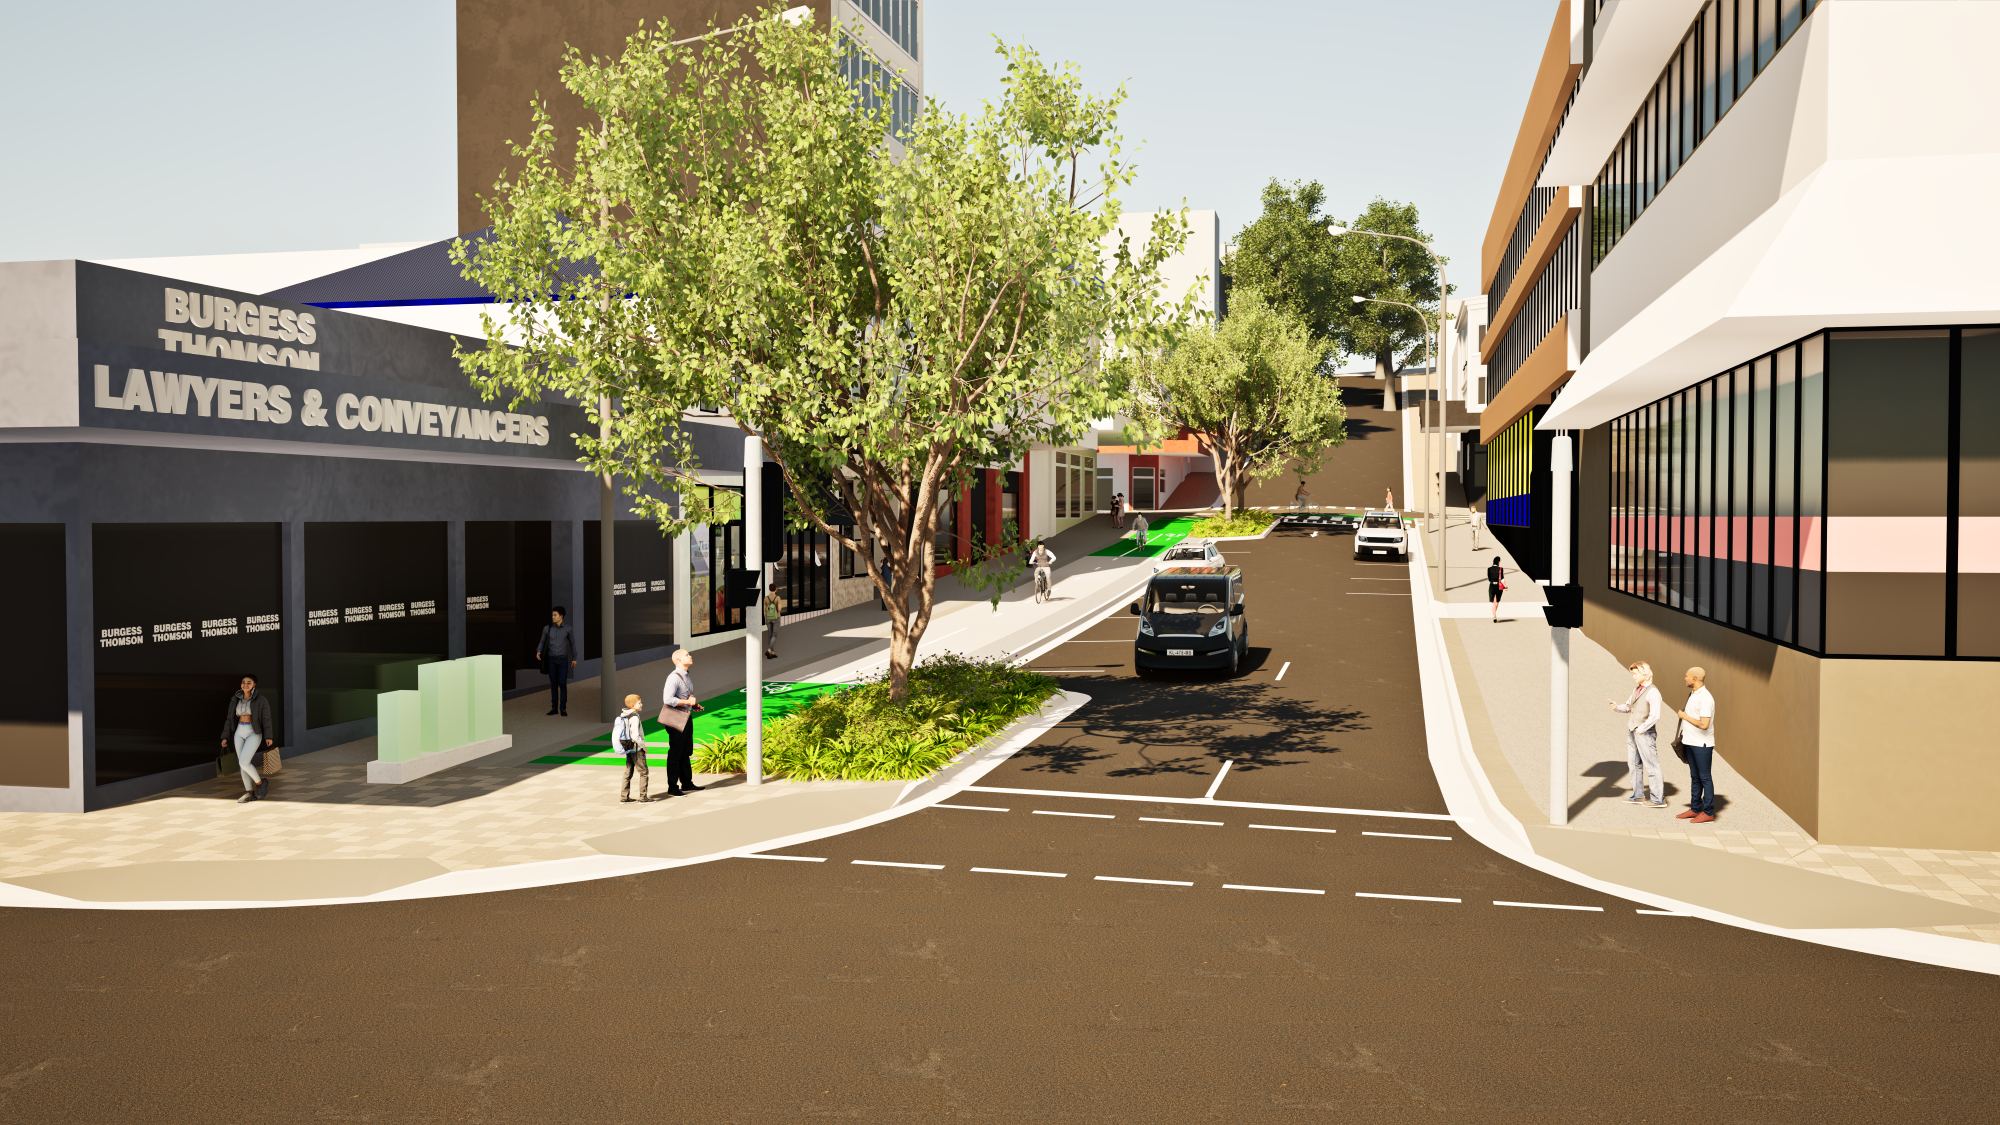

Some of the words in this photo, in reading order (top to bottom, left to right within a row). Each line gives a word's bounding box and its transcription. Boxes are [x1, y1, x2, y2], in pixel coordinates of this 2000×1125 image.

[164, 287, 316, 344] BURGESS
[94, 364, 292, 424] LAWYERS
[300, 389, 328, 428] &
[336, 392, 549, 446] CONVEYANCERS
[379, 603, 404, 612] BURGESS
[411, 600, 435, 609] BURGESS
[466, 602, 489, 610] THOMSON
[309, 609, 338, 618] BURGESS
[345, 606, 372, 615] BURGESS
[378, 610, 405, 619] THOMSON
[410, 608, 435, 616] THOMSON
[247, 614, 279, 624] BURGESS
[308, 617, 339, 626] THOMSON
[344, 613, 373, 622] THOMSON
[154, 622, 191, 633] BURGESS
[202, 618, 237, 628] BURGESS
[246, 622, 280, 633] THOMSON
[102, 626, 142, 638] BURGESS
[153, 631, 192, 642] THOMSON
[201, 627, 238, 637] THOMSON
[100, 636, 143, 647] THOMSON
